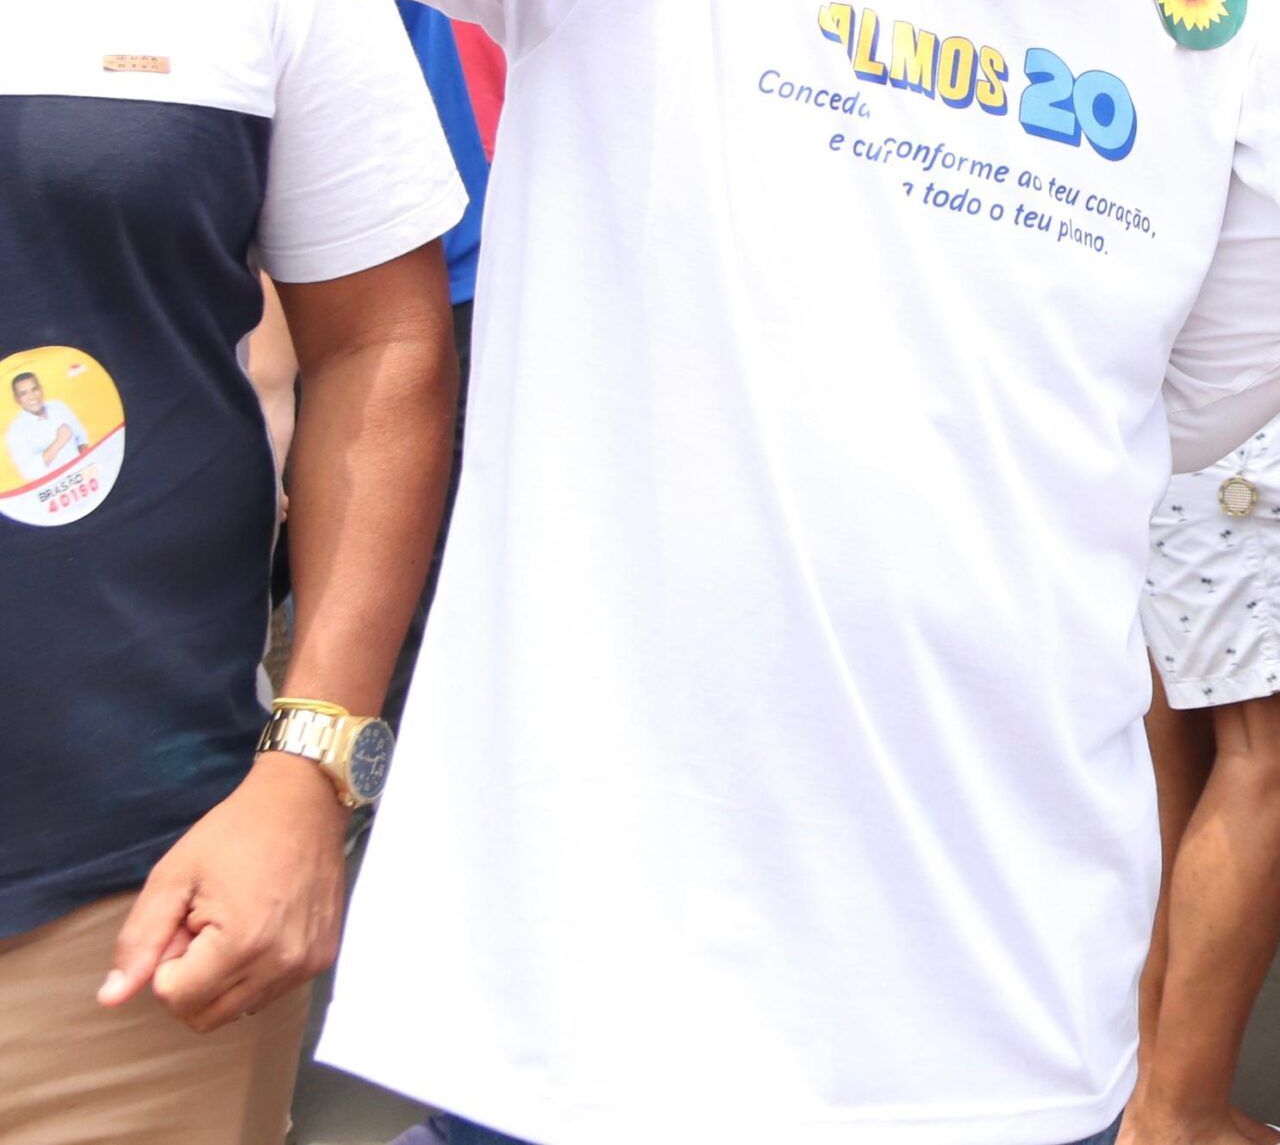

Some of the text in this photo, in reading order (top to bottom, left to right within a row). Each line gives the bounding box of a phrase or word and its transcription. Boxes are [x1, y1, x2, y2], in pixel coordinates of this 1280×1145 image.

[1019, 47, 1137, 161] 20
[829, 133, 845, 151] e
[923, 182, 982, 216] todo
[989, 203, 1004, 221] o
[1014, 203, 1052, 232] teu
[1057, 218, 1108, 255] plano.
[1018, 170, 1043, 191] ao
[1049, 177, 1080, 206] teu
[1085, 194, 1156, 239] coração,
